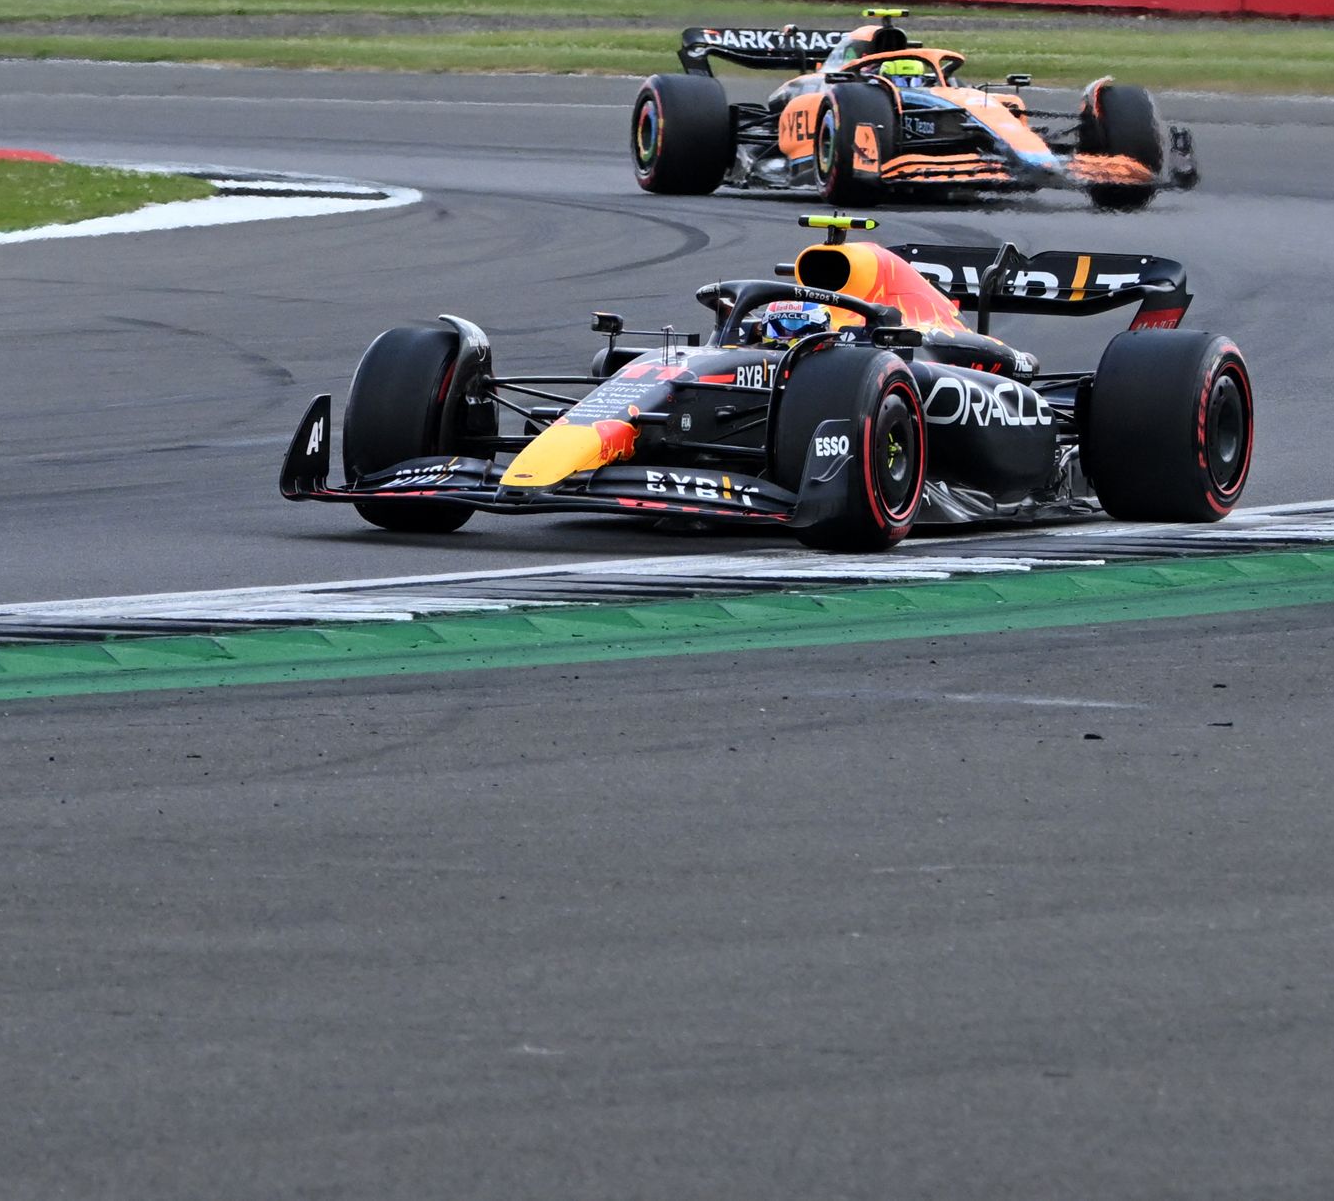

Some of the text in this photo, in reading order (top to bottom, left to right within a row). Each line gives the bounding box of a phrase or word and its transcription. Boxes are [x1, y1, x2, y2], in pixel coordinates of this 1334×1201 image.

[704, 29, 851, 50] DARKTRAC
[804, 289, 831, 301] Tezos
[768, 312, 810, 321] ORACLE
[788, 303, 803, 311] Bull
[736, 358, 777, 390] BYBIT
[924, 376, 1054, 427] ORACLE
[306, 416, 324, 456] A1
[814, 435, 850, 457] ESSO
[646, 470, 760, 506] BYBIT
